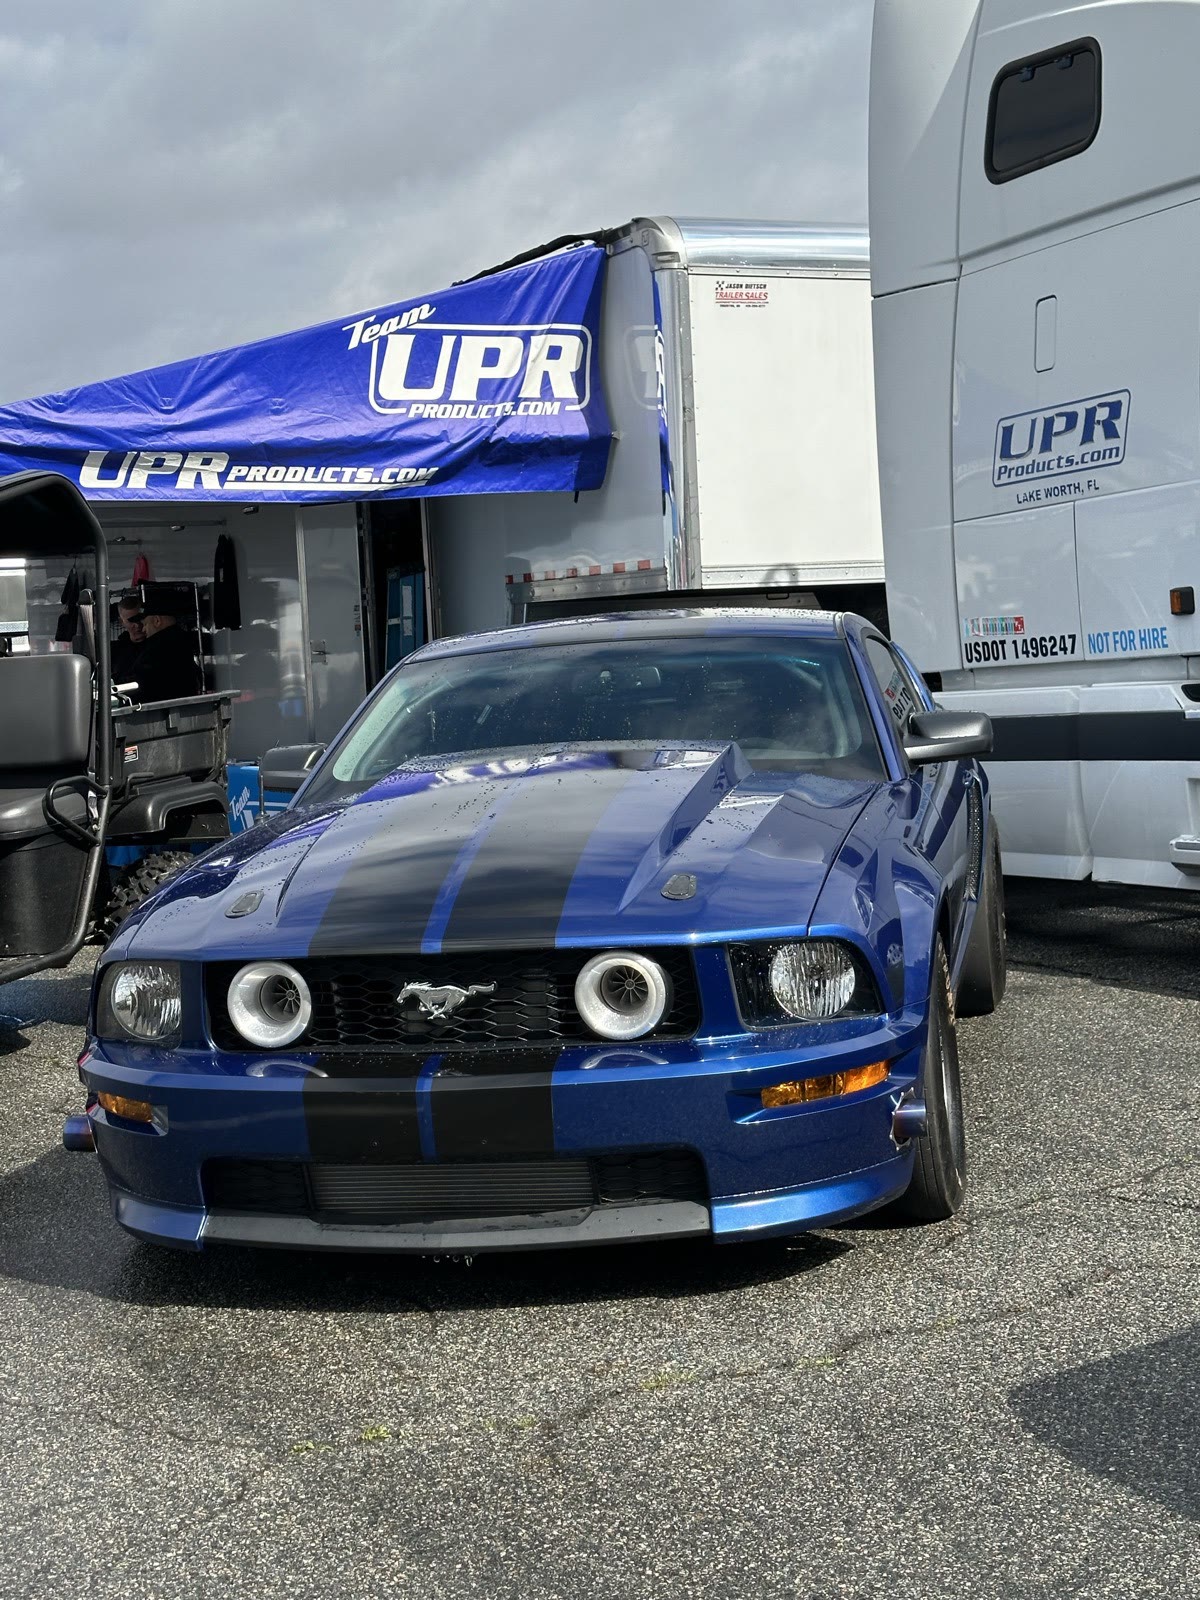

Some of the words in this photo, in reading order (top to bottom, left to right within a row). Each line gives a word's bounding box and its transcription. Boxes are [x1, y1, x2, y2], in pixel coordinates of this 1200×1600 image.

[715, 291, 744, 299] TRAILER
[744, 291, 769, 300] SALES
[342, 303, 436, 350] Team
[378, 334, 584, 401] UPR
[407, 401, 562, 419] PRODUCTS.COM
[1000, 400, 1123, 461] UPR
[79, 450, 231, 490] UPR
[225, 465, 440, 484] PRODUCTS.COM
[997, 446, 1121, 481] Products.com
[1016, 487, 1042, 504] LAKE
[1044, 482, 1085, 499] WORTH,
[1087, 479, 1100, 492] FL
[964, 639, 1007, 664] USDOT
[1012, 633, 1078, 660] 1496247
[1088, 631, 1110, 655] NOT
[1113, 629, 1137, 651] FOR
[1138, 626, 1169, 649] HIRE
[229, 786, 251, 821] Team
